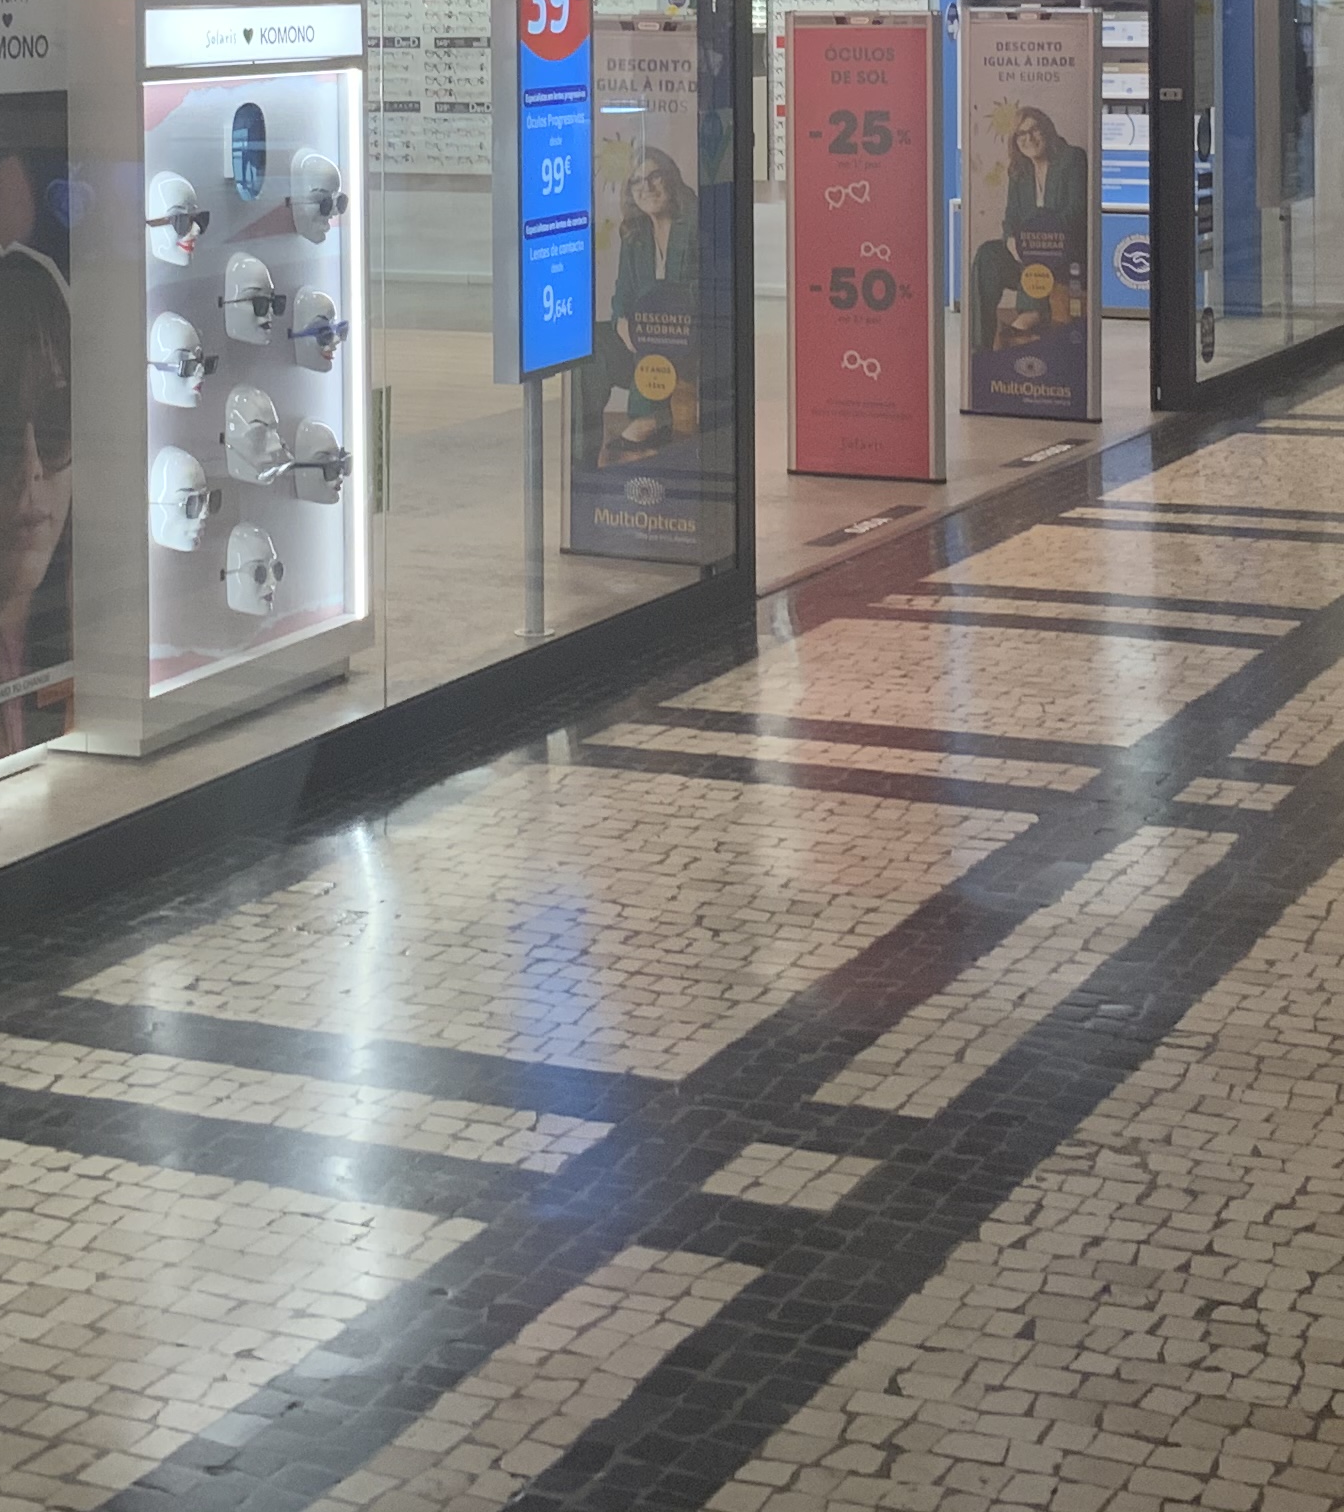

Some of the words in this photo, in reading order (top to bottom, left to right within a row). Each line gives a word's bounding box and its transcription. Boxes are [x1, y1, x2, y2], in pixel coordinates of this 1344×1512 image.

[205, 29, 237, 48] Solaris
[260, 25, 315, 45] KOMONO
[824, 43, 896, 62] ÓCULOS
[996, 41, 1063, 52] DESCONTO
[607, 57, 692, 73] DESCONTO
[983, 56, 1021, 67] IGUAL
[1024, 55, 1033, 67] À
[1037, 56, 1076, 67] IDADE
[596, 78, 639, 93] GUAL
[643, 75, 654, 93] À
[659, 80, 698, 93] IDAD
[830, 70, 851, 85] DE
[857, 70, 889, 85] SOL
[998, 71, 1016, 82] EM
[1020, 71, 1061, 83] EUROS
[808, 109, 912, 157] -25%
[541, 154, 572, 196] 99€
[550, 243, 558, 257] de
[809, 266, 913, 313] -50%
[634, 312, 691, 325] DESCONTO
[990, 379, 1072, 399] MultiOpticas
[594, 507, 697, 534] MultiOpticas
